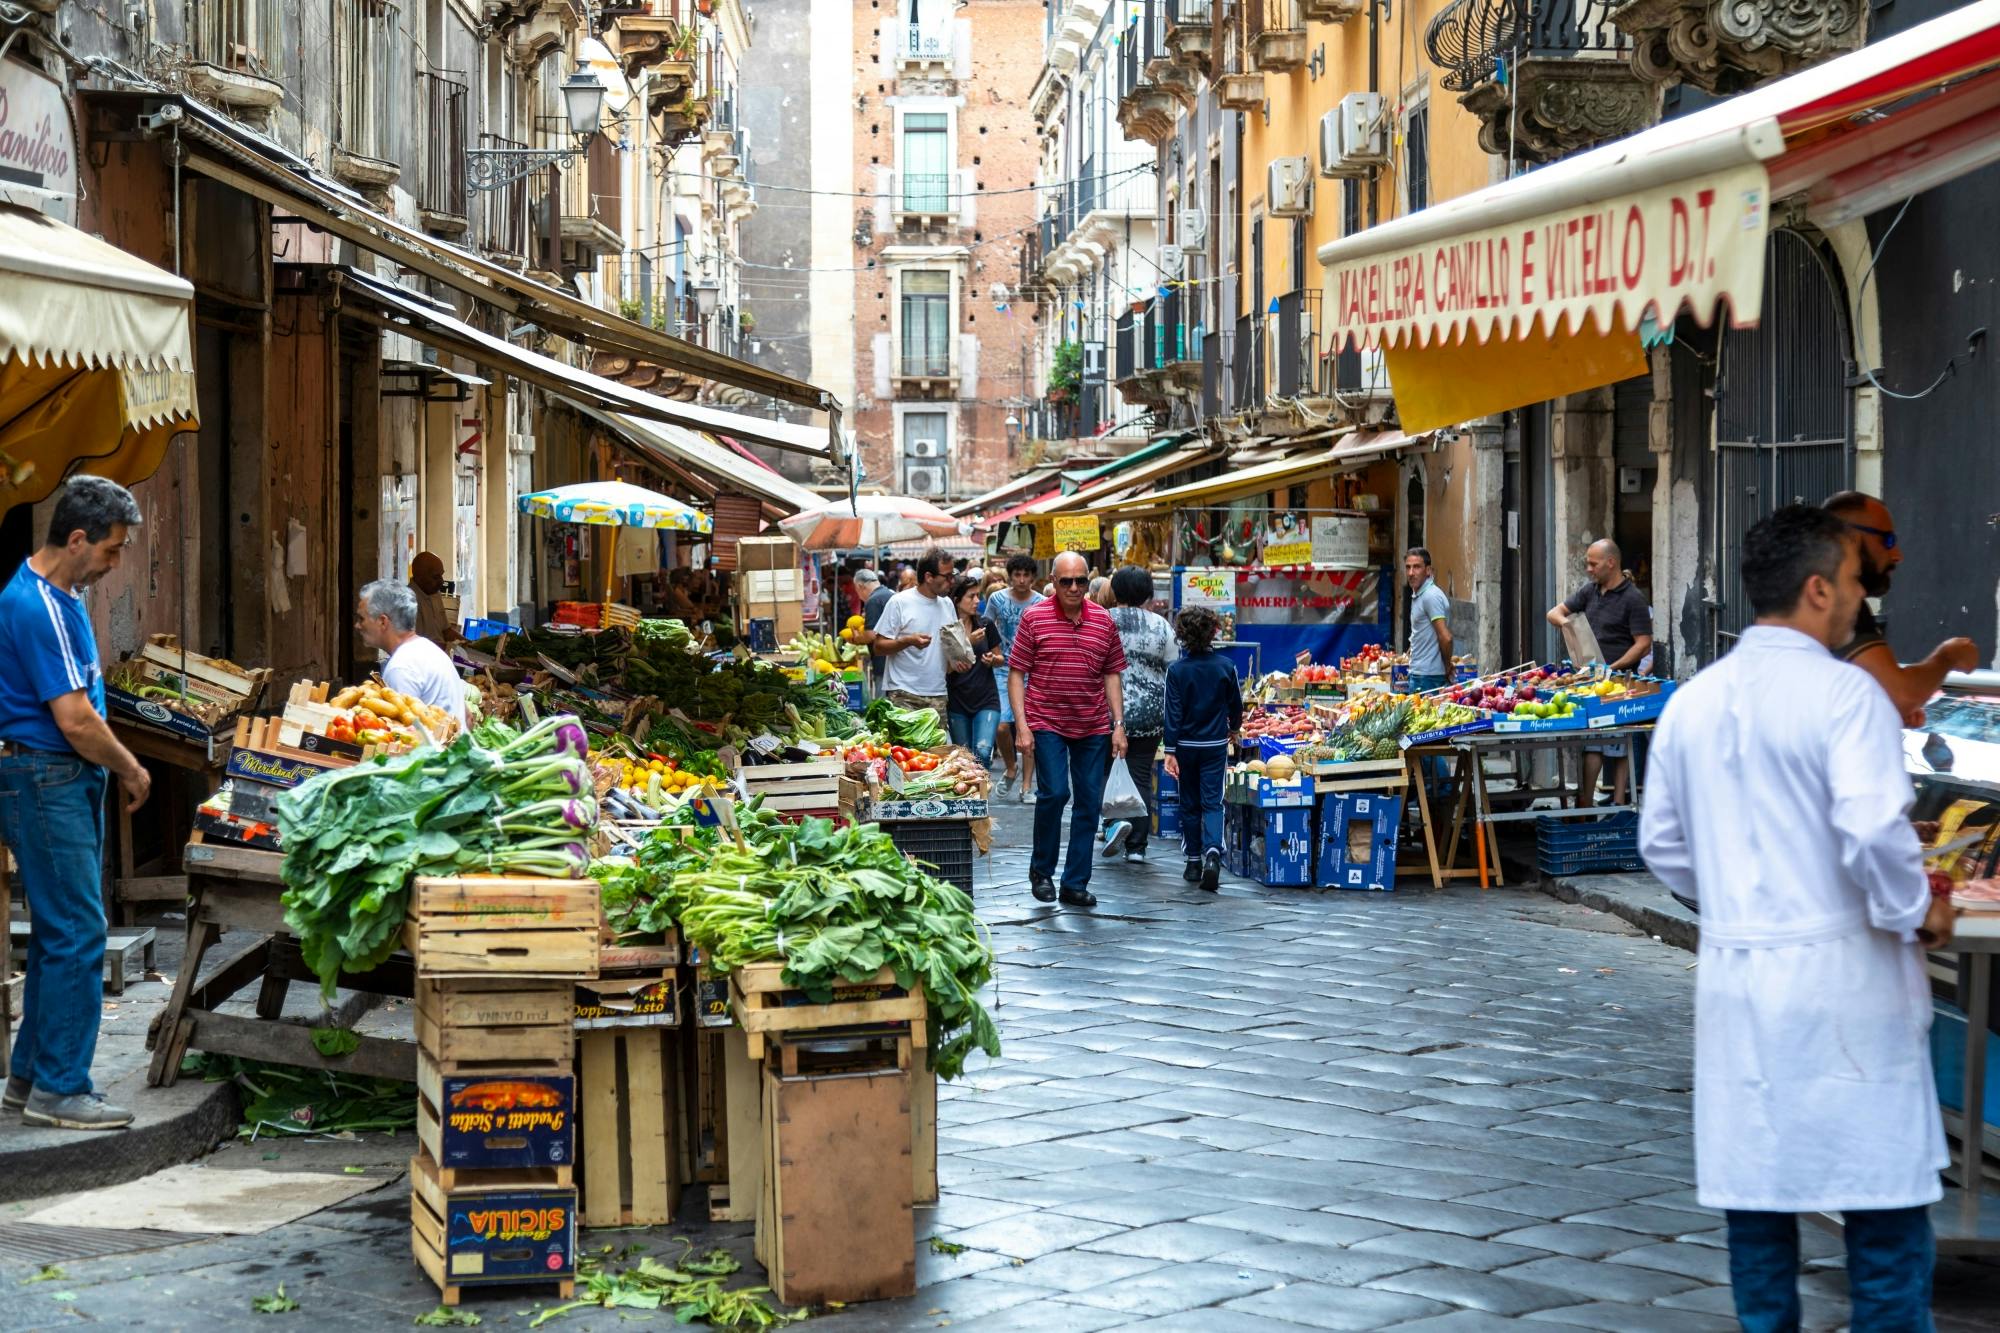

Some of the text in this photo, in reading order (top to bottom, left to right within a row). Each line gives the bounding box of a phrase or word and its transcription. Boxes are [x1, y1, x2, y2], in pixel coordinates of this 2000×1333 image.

[1521, 230, 1535, 305] E
[1545, 204, 1646, 301] VITELLO
[1187, 575, 1224, 588] SICILIA
[1203, 586, 1229, 598] VERA
[1235, 595, 1299, 608] LUMERIA
[234, 751, 301, 780] Meridional
[449, 1110, 565, 1133] Prodotti di Sicilia
[468, 1207, 565, 1233] SICILIA
